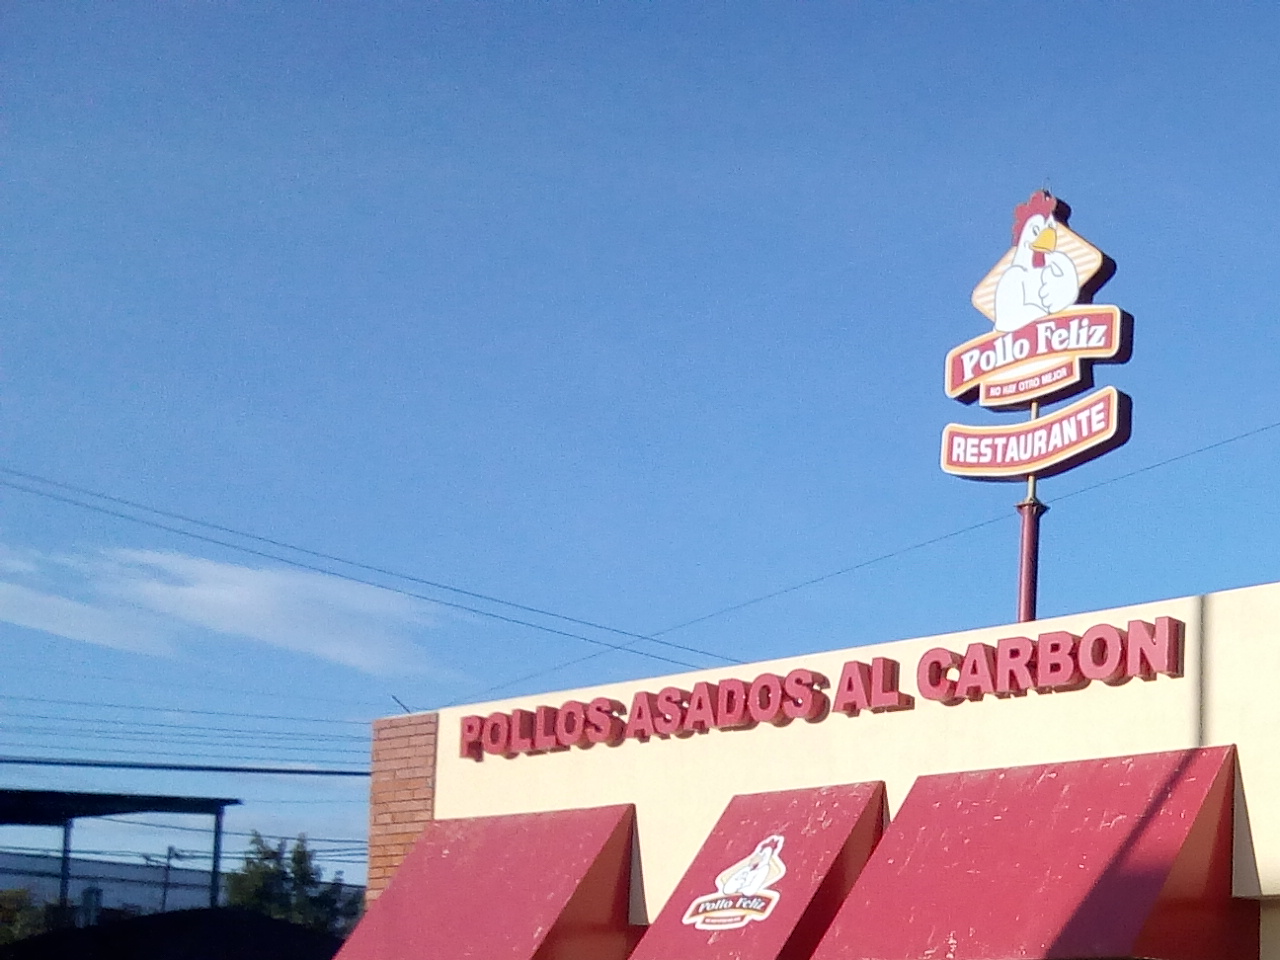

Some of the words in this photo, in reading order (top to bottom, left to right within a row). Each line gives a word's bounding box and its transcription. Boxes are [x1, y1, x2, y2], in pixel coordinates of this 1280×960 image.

[960, 332, 1030, 382] Pollo
[1035, 318, 1108, 354] Feliz
[989, 386, 1001, 396] NO
[1018, 377, 1040, 391] OTRO
[1041, 367, 1068, 385] MEJOR
[951, 401, 1106, 464] RESTAURANTE
[459, 697, 622, 760] POLLOS
[626, 668, 824, 742] ASADOS
[832, 656, 908, 716] AL
[916, 615, 1182, 705] CARBON
[698, 899, 733, 913] Pollo
[736, 897, 765, 909] Feliz
